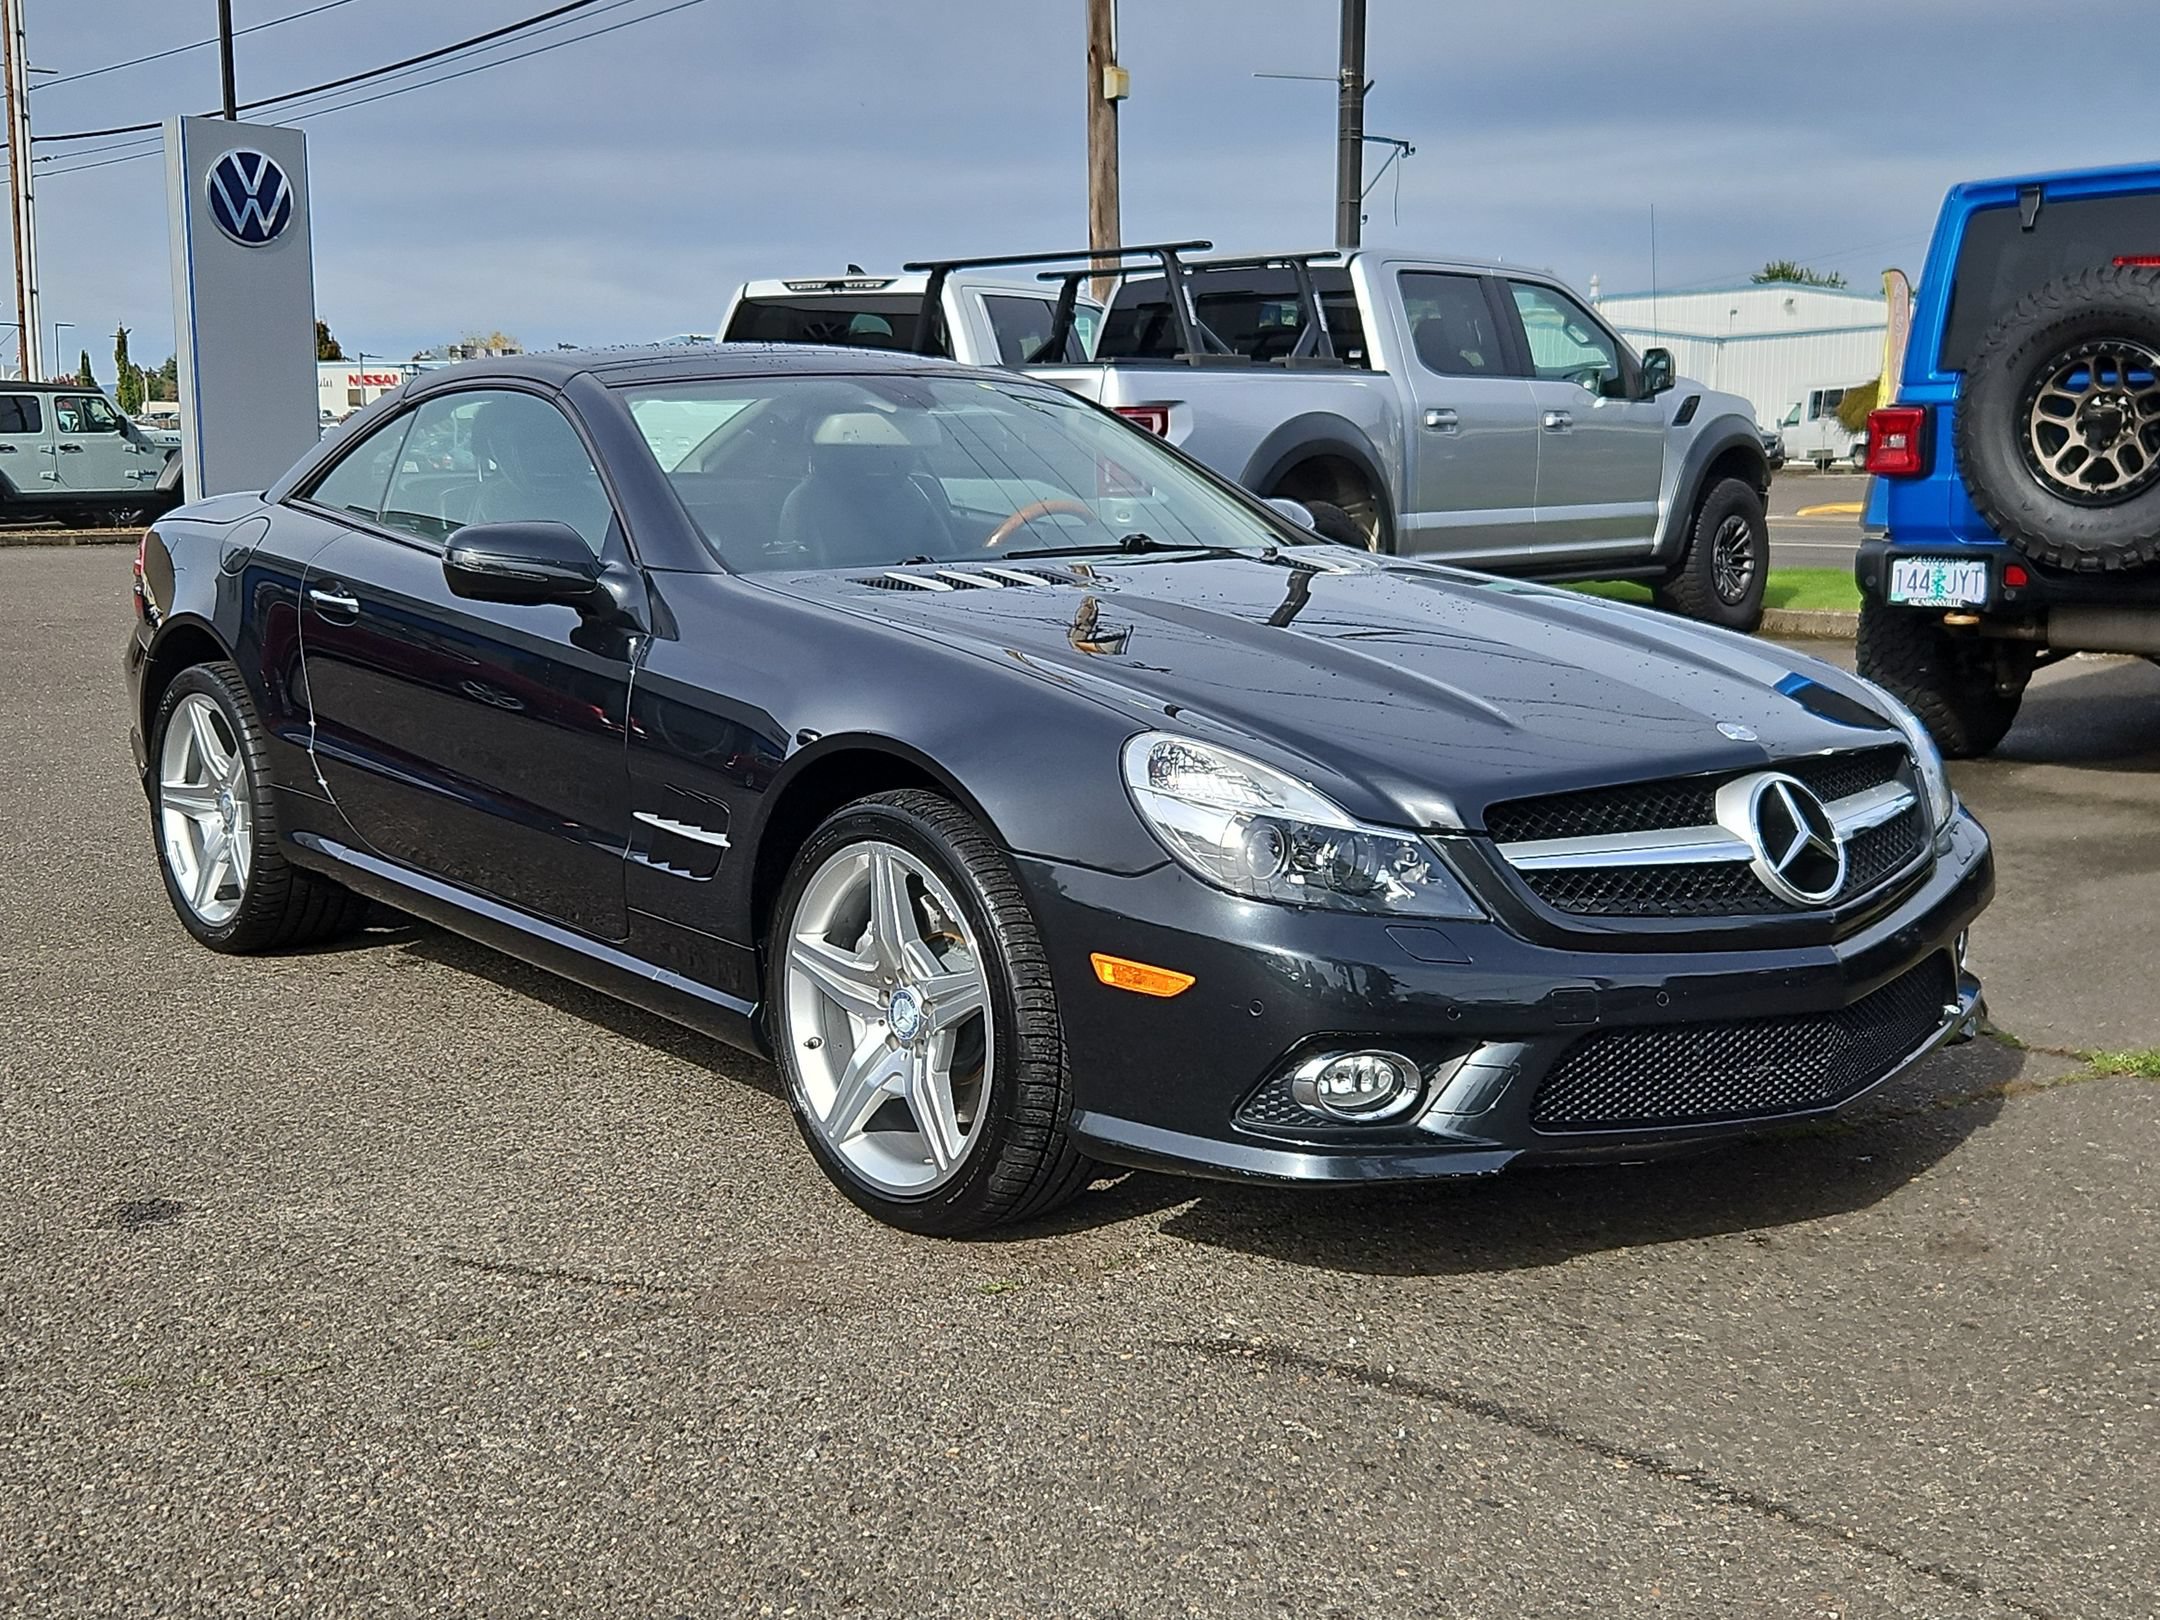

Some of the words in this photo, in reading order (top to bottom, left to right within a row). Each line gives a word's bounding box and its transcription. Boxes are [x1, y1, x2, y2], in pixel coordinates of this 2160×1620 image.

[211, 151, 289, 238] VW
[348, 374, 399, 386] NSSAN
[1897, 569, 1930, 593] 144
[1945, 569, 1982, 595] JYT
